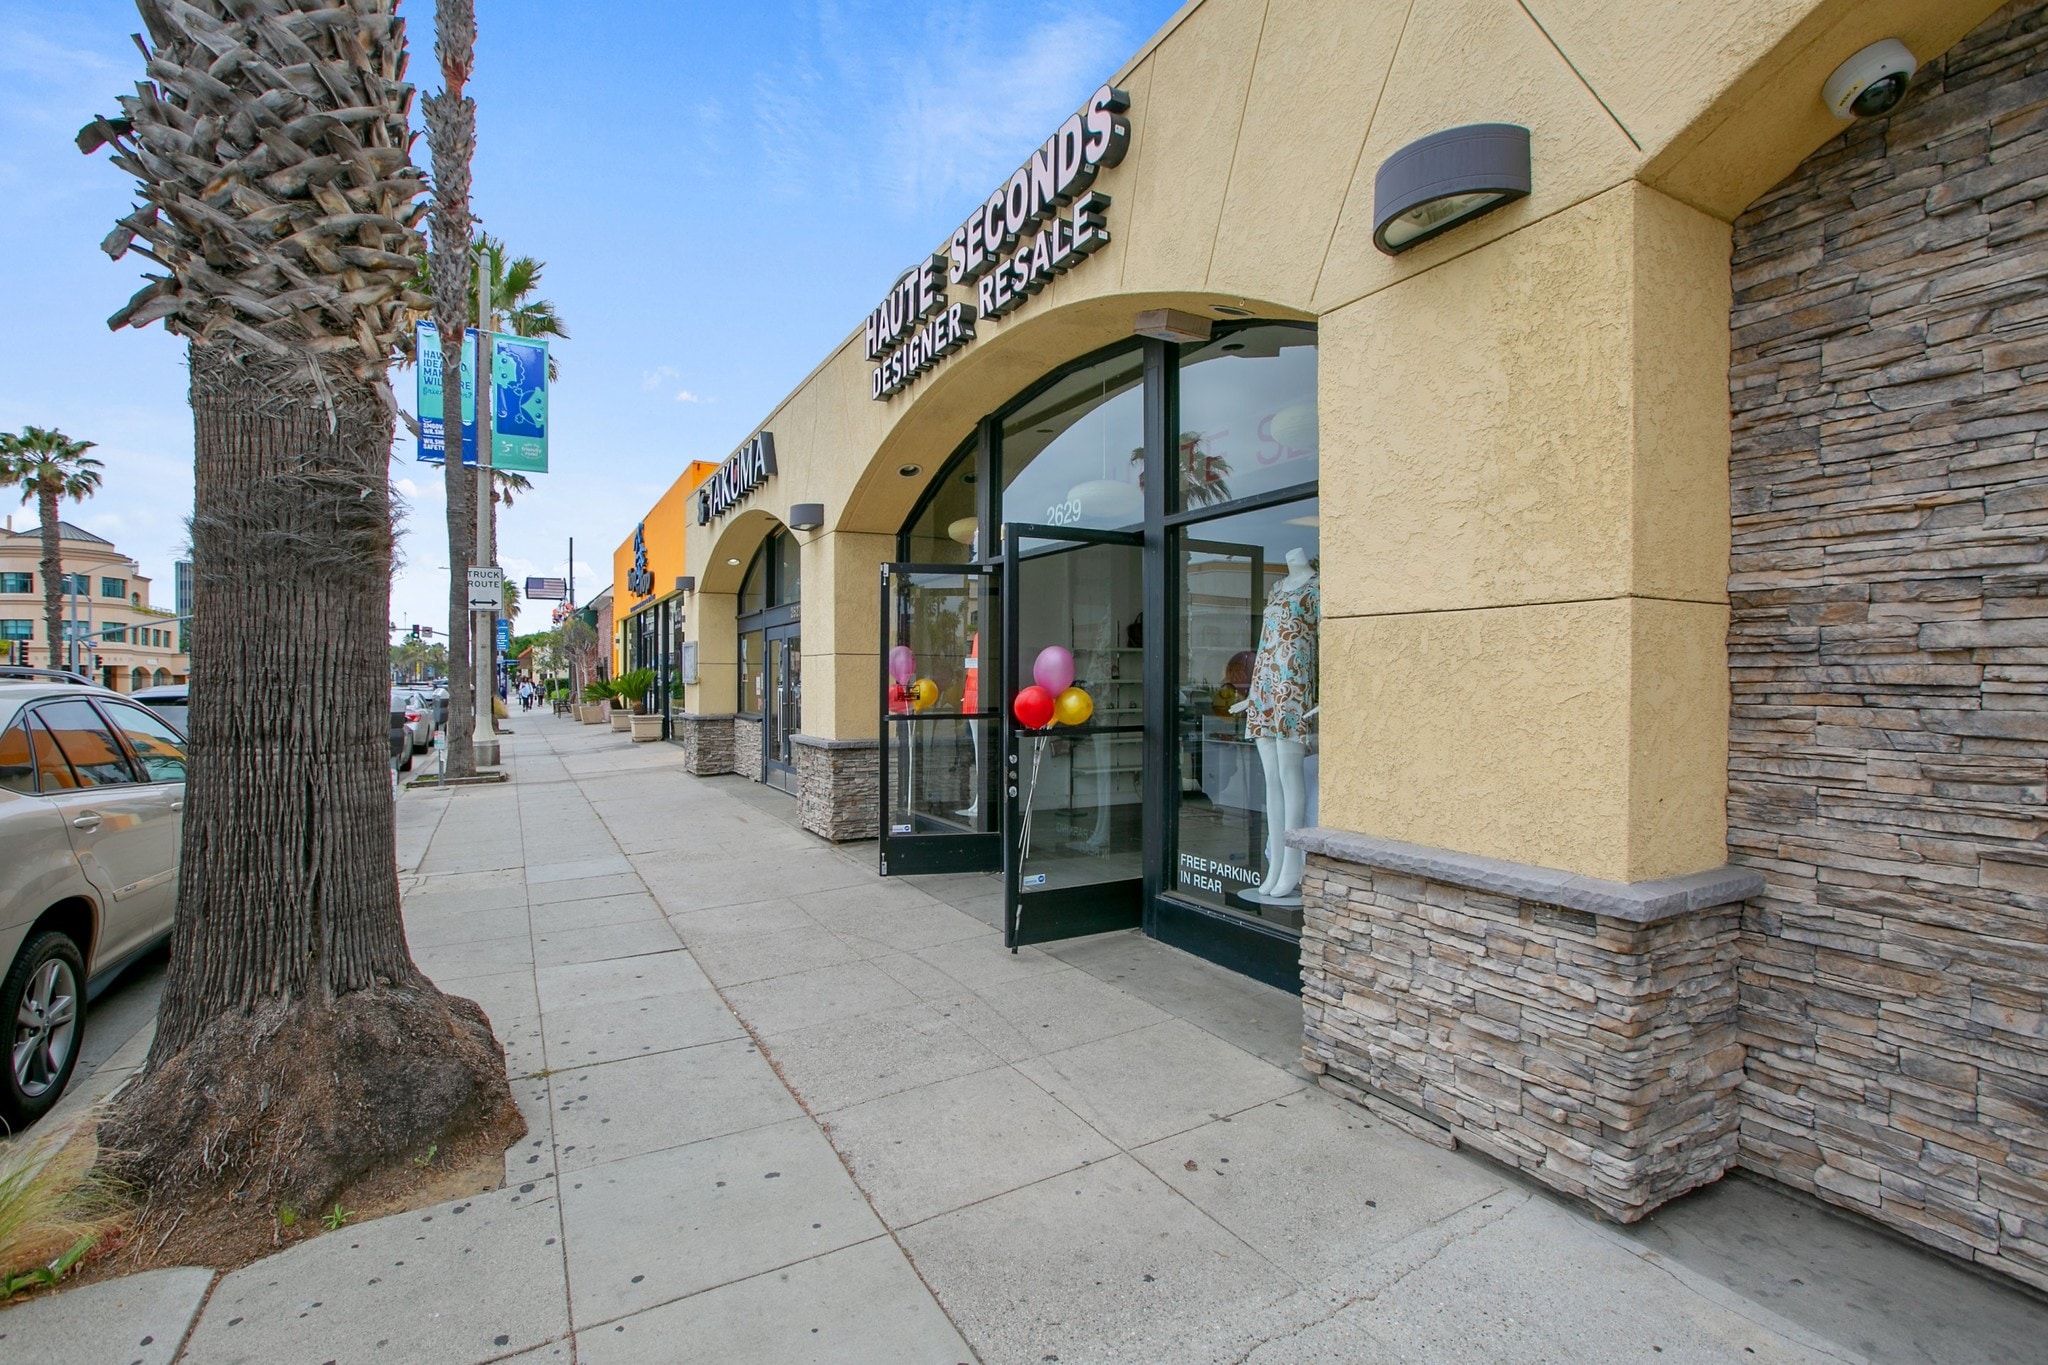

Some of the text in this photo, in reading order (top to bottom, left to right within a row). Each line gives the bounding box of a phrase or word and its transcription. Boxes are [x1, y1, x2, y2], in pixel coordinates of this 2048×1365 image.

[865, 84, 1120, 361] HAUTE SECONDS
[872, 191, 1099, 401] DESIGNER RESALE
[424, 350, 443, 360] HAV
[708, 431, 769, 519] TAKUMA
[1046, 499, 1082, 526] 2629
[467, 570, 500, 578] TRUCK
[467, 580, 500, 589] ROUTE
[1180, 853, 1261, 886] FREE PARKING
[1180, 870, 1223, 894] IN REAR
